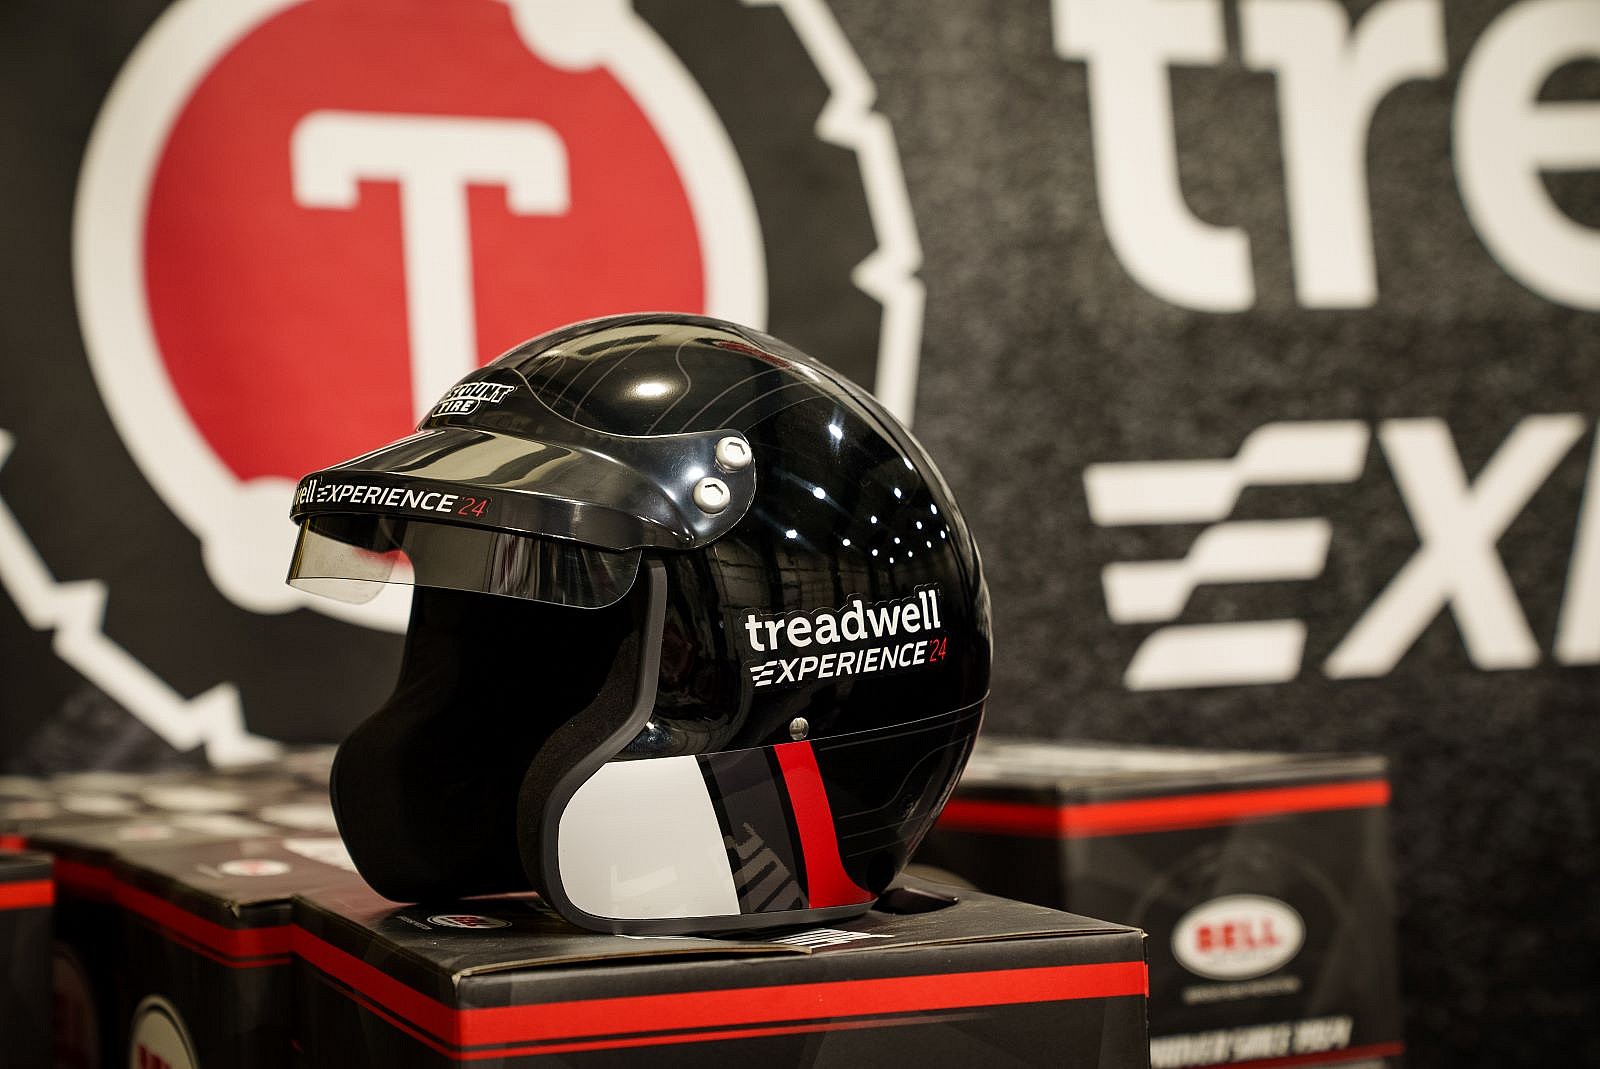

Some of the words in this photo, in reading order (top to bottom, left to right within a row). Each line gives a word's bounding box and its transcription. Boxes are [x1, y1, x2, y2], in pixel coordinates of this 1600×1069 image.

[289, 109, 571, 427] T
[438, 400, 475, 414] TIRE
[316, 484, 459, 513] EXPERIENCE
[745, 589, 941, 652] treadwell
[750, 640, 928, 687] EXPERIENCE
[1195, 919, 1280, 954] BELL
